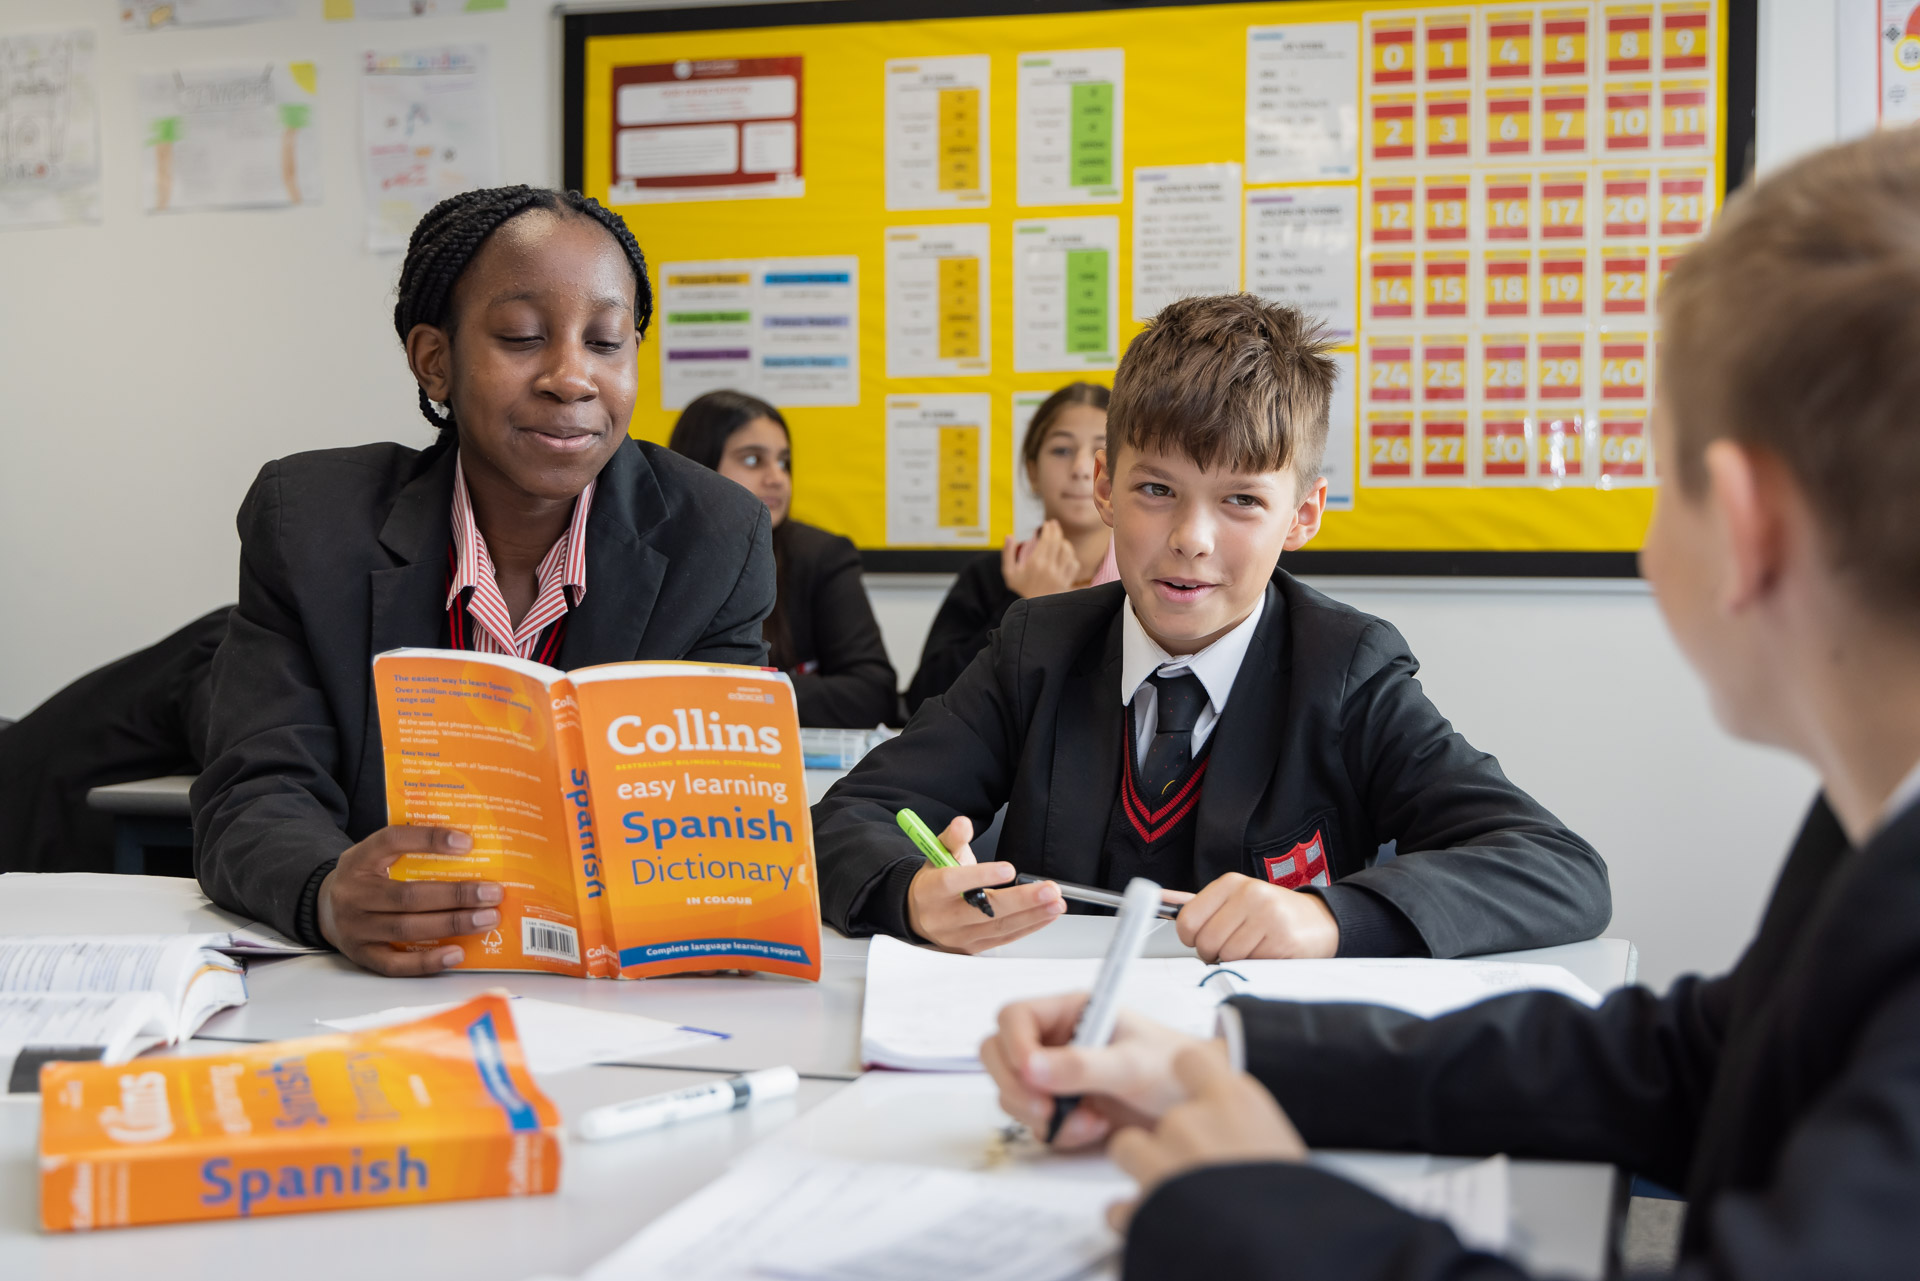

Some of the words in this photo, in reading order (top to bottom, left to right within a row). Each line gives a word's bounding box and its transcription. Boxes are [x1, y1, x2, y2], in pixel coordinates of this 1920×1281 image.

[1440, 42, 1453, 67] 1
[1500, 38, 1519, 65] 4
[1556, 35, 1574, 62] 5
[1619, 31, 1639, 58] 8
[1676, 29, 1695, 56] 9
[1382, 44, 1404, 70] 0
[1385, 119, 1403, 146] 2
[1439, 116, 1456, 143] 3
[1500, 114, 1519, 141] 6
[1555, 112, 1574, 138] 7
[1611, 109, 1646, 136] 10
[1672, 107, 1698, 133] 11
[1378, 202, 1409, 229] 12
[1431, 201, 1462, 227] 13
[1492, 199, 1524, 226] 16
[1548, 199, 1579, 225] 17
[1606, 196, 1646, 223] 20
[1667, 195, 1699, 221] 21
[1377, 278, 1407, 304] 14
[1430, 276, 1462, 303] 15
[1491, 276, 1524, 303] 18
[1547, 275, 1579, 301] 19
[1607, 273, 1643, 300] 22
[1373, 361, 1408, 388] 24
[1427, 361, 1462, 387] 25
[1487, 360, 1524, 387] 28
[1542, 359, 1578, 386] 29
[1602, 358, 1643, 385] 40
[1373, 438, 1408, 464] 26
[1427, 437, 1462, 464] 27
[1486, 437, 1524, 464] 30
[1602, 436, 1643, 463] 60
[394, 674, 409, 682] The
[412, 675, 439, 683] easiest
[469, 679, 487, 687] learn
[422, 687, 446, 695] million
[449, 689, 471, 698] copies
[482, 692, 492, 700] the
[607, 708, 782, 755] Collins
[402, 749, 416, 757] Easy
[454, 792, 488, 802] supplement
[618, 779, 676, 801] easy
[684, 773, 788, 804] learning
[405, 799, 427, 807] phrases
[437, 800, 453, 808] speak
[566, 768, 606, 898] Spanish
[622, 806, 793, 849] Spanish
[632, 853, 793, 891] Dictionary
[687, 897, 700, 905] IN
[704, 896, 752, 905] COLOUR
[646, 945, 689, 956] Complete
[691, 942, 732, 950] language
[733, 942, 768, 953] learning
[770, 947, 801, 957] support
[200, 1145, 429, 1217] Spanish
